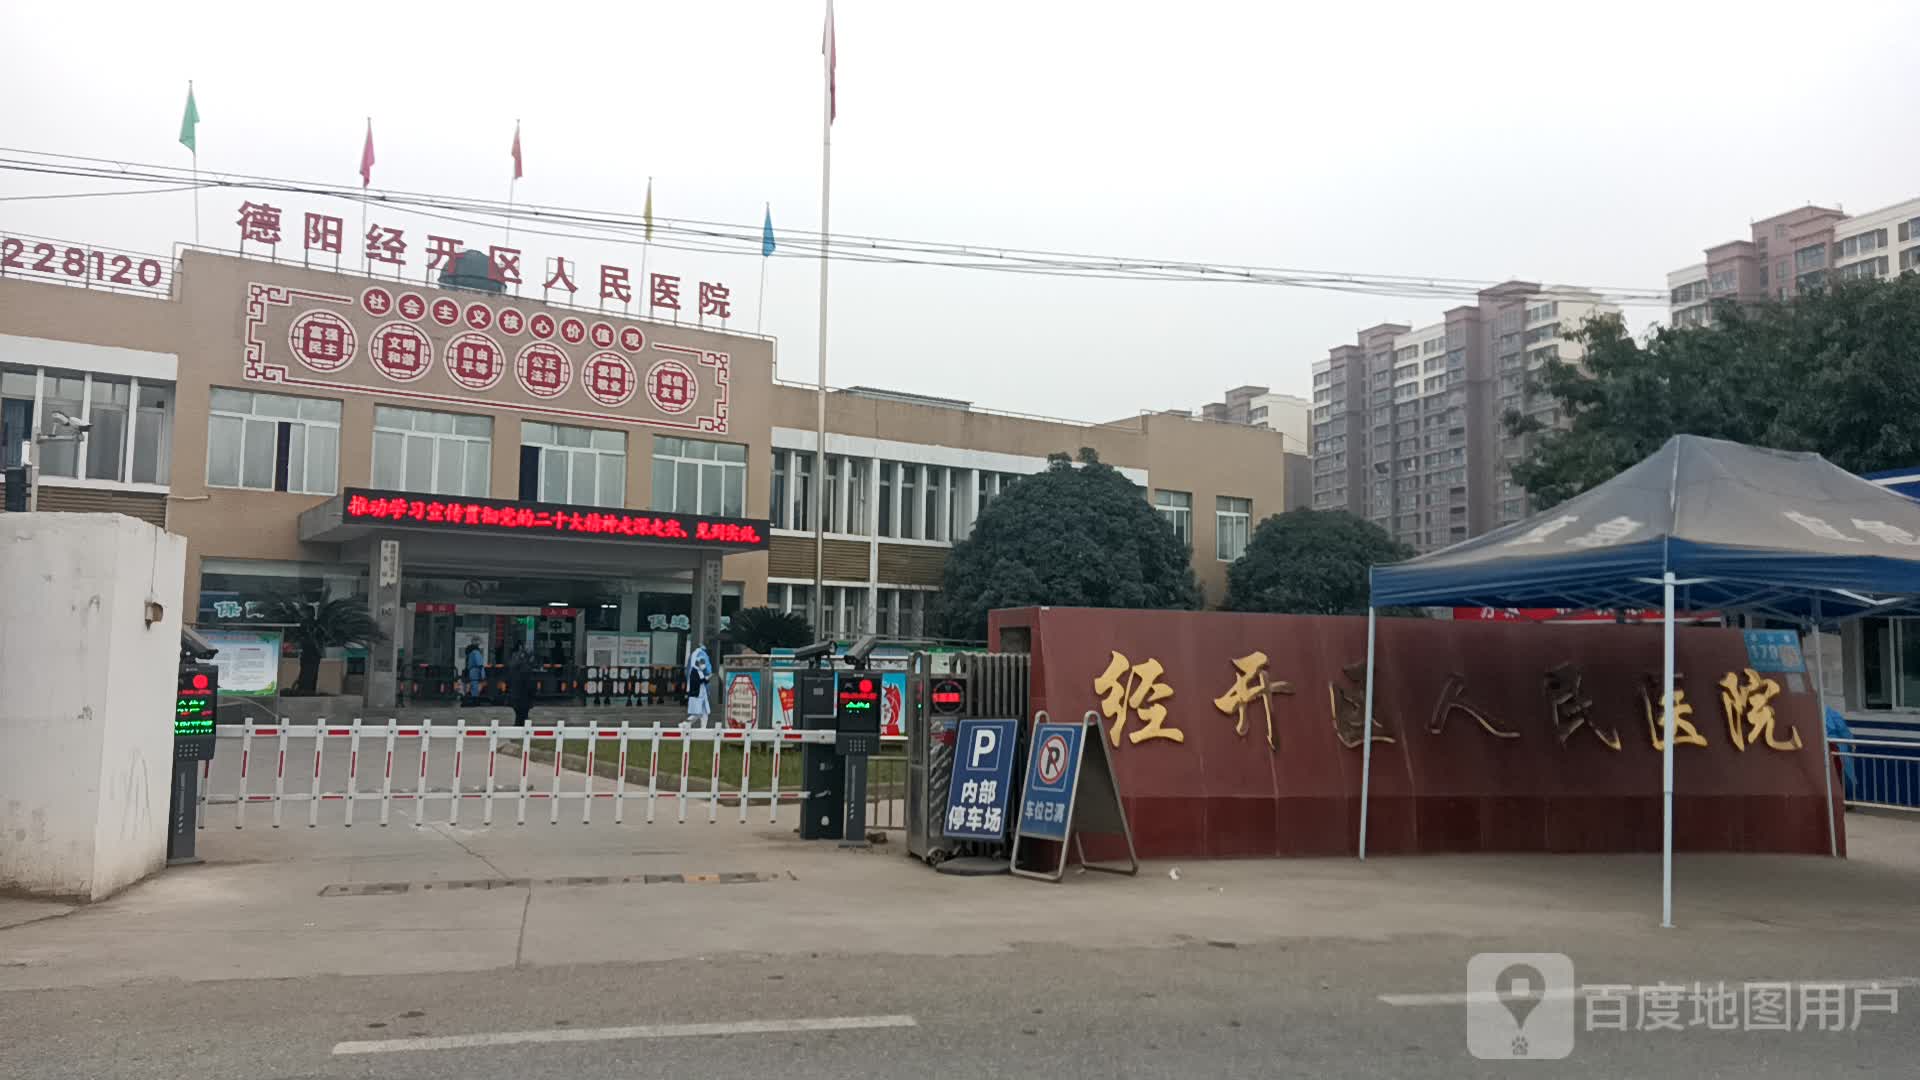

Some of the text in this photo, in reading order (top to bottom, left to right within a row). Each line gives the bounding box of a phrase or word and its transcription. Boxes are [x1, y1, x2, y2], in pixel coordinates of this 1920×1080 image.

[1, 238, 161, 287] 228120
[236, 200, 731, 319] 德阳经开区人民医院
[368, 293, 640, 347] 社会主义核心价值观
[1094, 650, 1802, 753] 经开区人民医院
[972, 729, 996, 768] P
[961, 779, 998, 805] 内部
[1024, 799, 1066, 824] 车位已满
[949, 804, 1002, 833] 停车场
